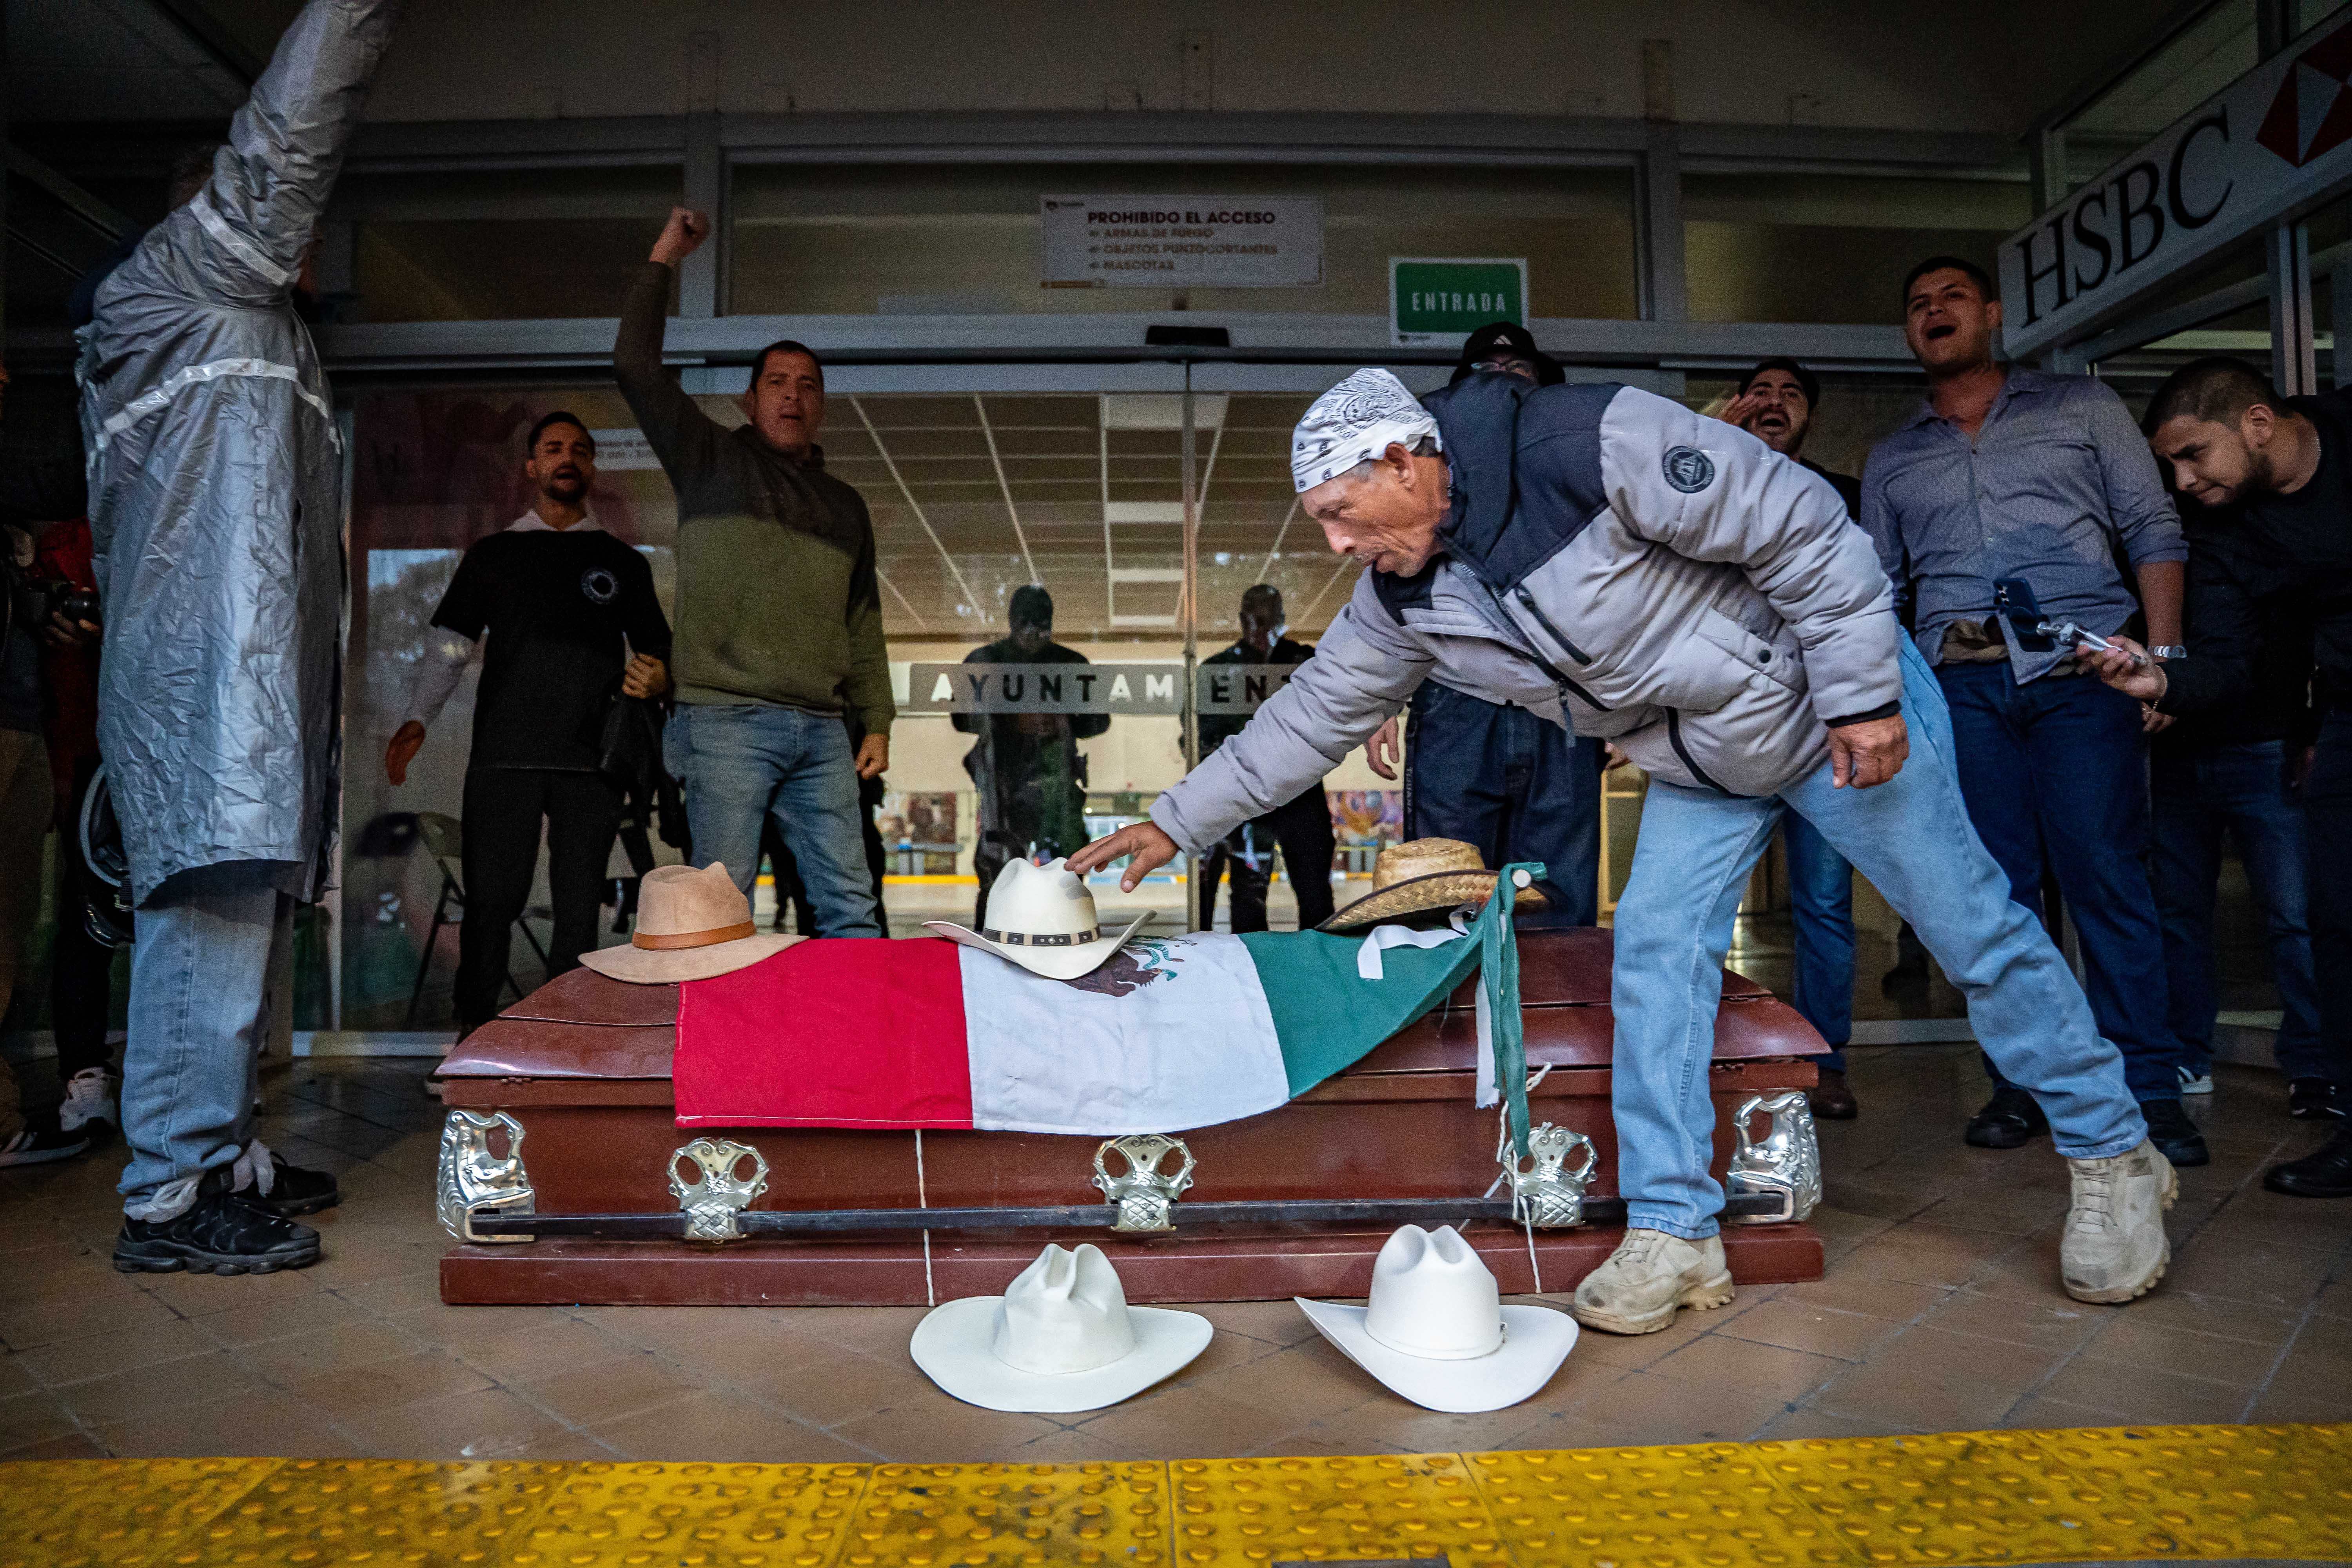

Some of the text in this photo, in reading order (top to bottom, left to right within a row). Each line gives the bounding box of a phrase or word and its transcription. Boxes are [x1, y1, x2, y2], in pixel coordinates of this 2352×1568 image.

[1088, 211, 1276, 224] PROHIBIDO EL ACCESO
[2016, 104, 2234, 329] HSBC
[1104, 228, 1149, 238] ARMAS
[1151, 228, 1167, 238] DE
[1103, 244, 1278, 255] OBJETOS PUNZOCORTANTES
[1103, 260, 1175, 270] MASCOTAS
[1412, 291, 1506, 312] ENTRADA
